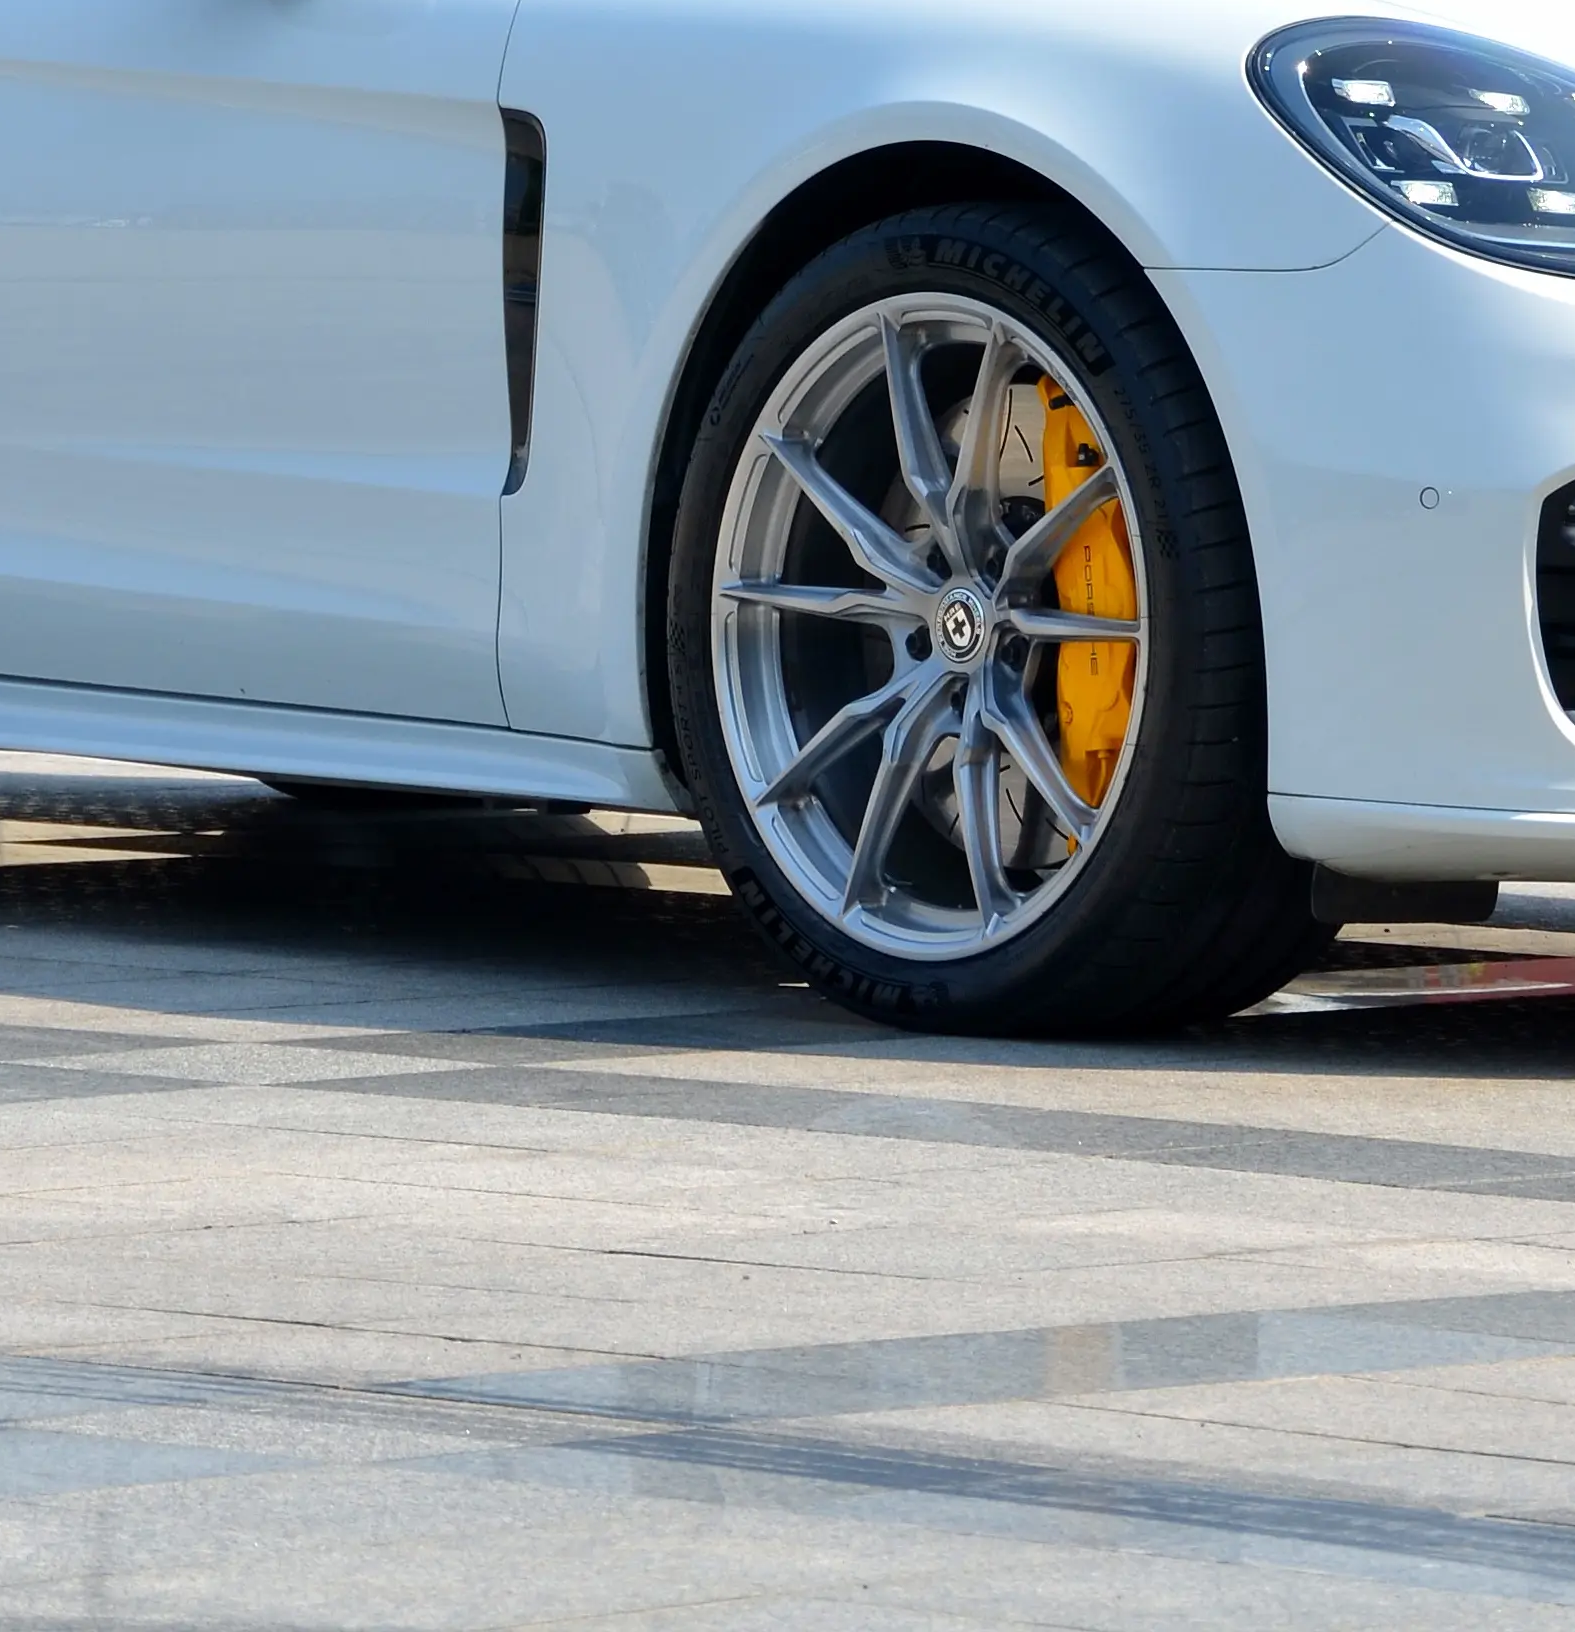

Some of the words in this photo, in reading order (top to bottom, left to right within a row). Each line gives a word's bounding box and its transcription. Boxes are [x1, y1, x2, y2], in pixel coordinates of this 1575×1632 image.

[932, 237, 1109, 364] MICHELIN
[1083, 544, 1099, 676] PORSHE
[737, 878, 902, 1007] MICHELIN
